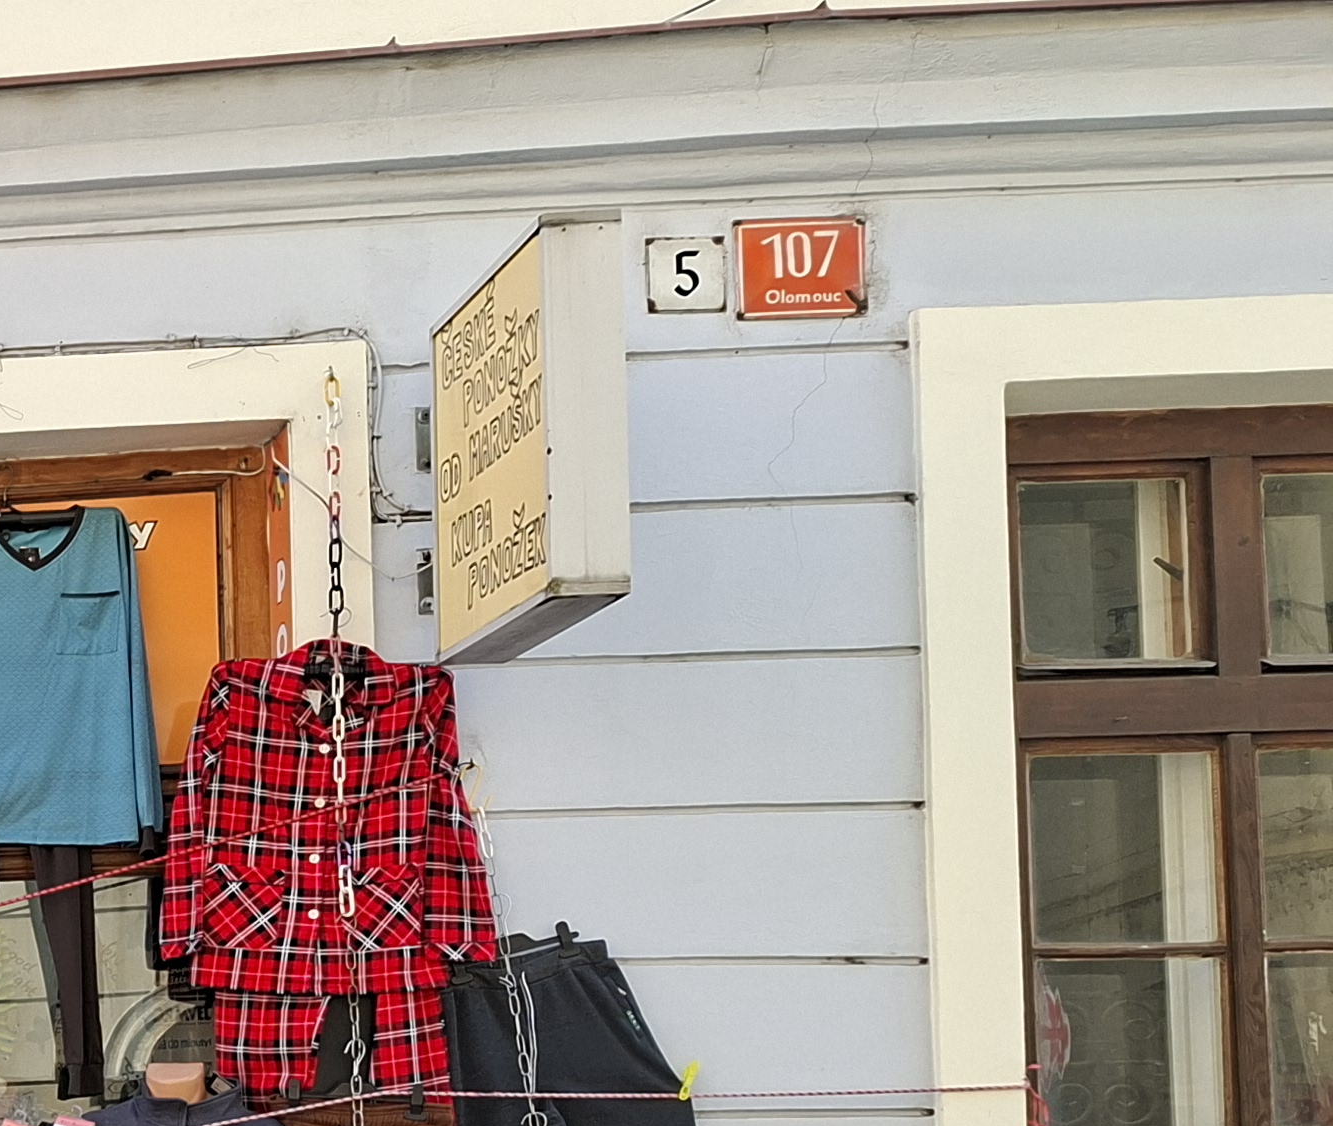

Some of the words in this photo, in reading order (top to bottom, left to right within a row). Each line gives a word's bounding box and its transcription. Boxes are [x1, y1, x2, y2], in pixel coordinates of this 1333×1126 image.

[674, 250, 700, 297] 5
[760, 230, 839, 279] 107
[765, 289, 842, 304] Olomouc
[440, 278, 496, 390] ČESKÉ
[463, 307, 540, 428] PONOŽKY
[440, 452, 461, 503] OD
[469, 372, 542, 482] MARUŠKY
[451, 498, 492, 567] KUPA
[468, 502, 546, 610] PONOŽEK
